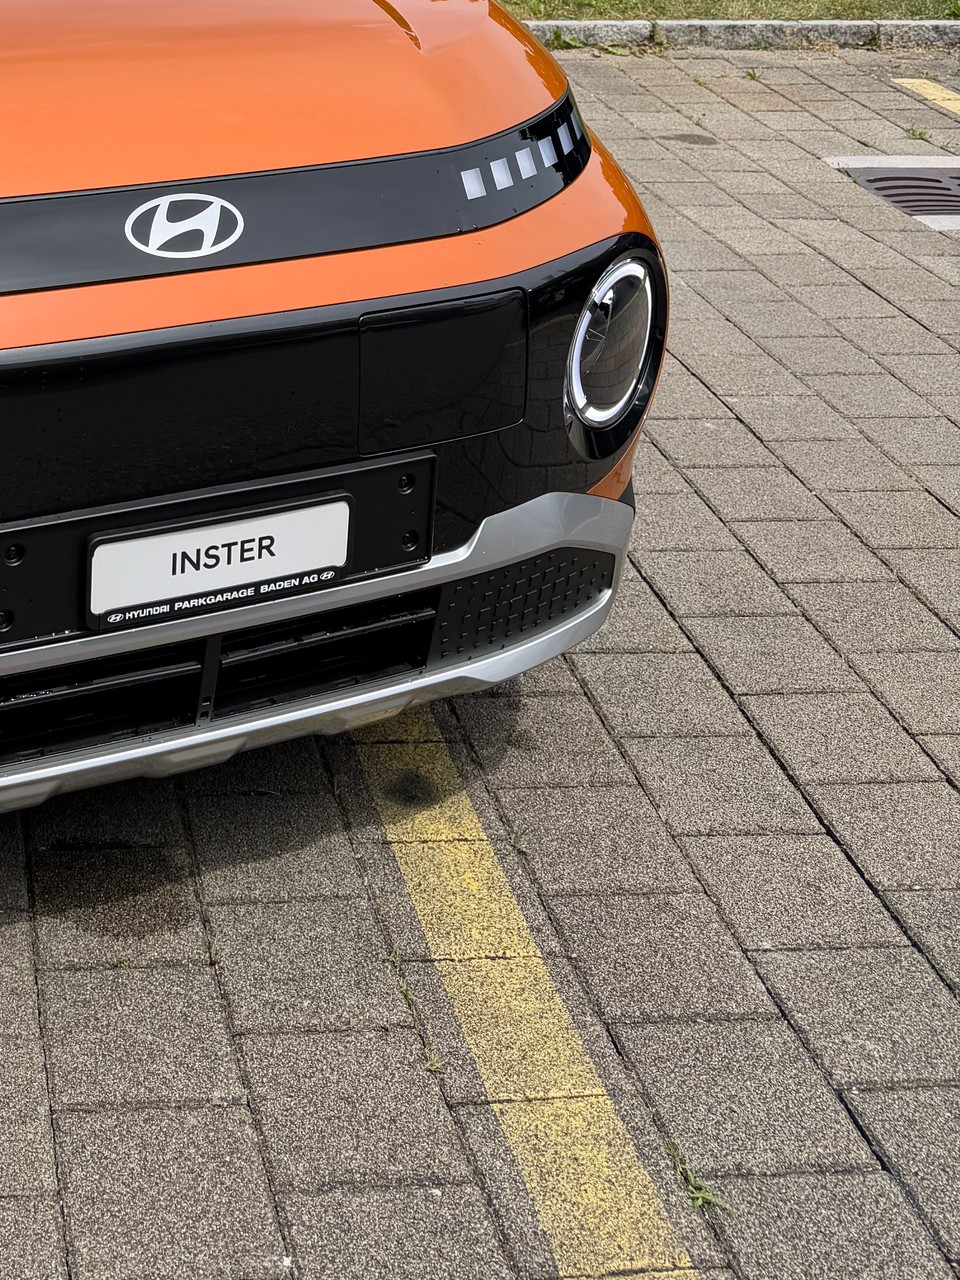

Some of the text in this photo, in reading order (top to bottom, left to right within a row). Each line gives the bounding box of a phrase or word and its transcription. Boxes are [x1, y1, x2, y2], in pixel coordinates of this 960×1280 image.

[171, 535, 277, 576] INSTER
[125, 574, 319, 620] HYUNDAI PARKGARAGE BADEN AG
